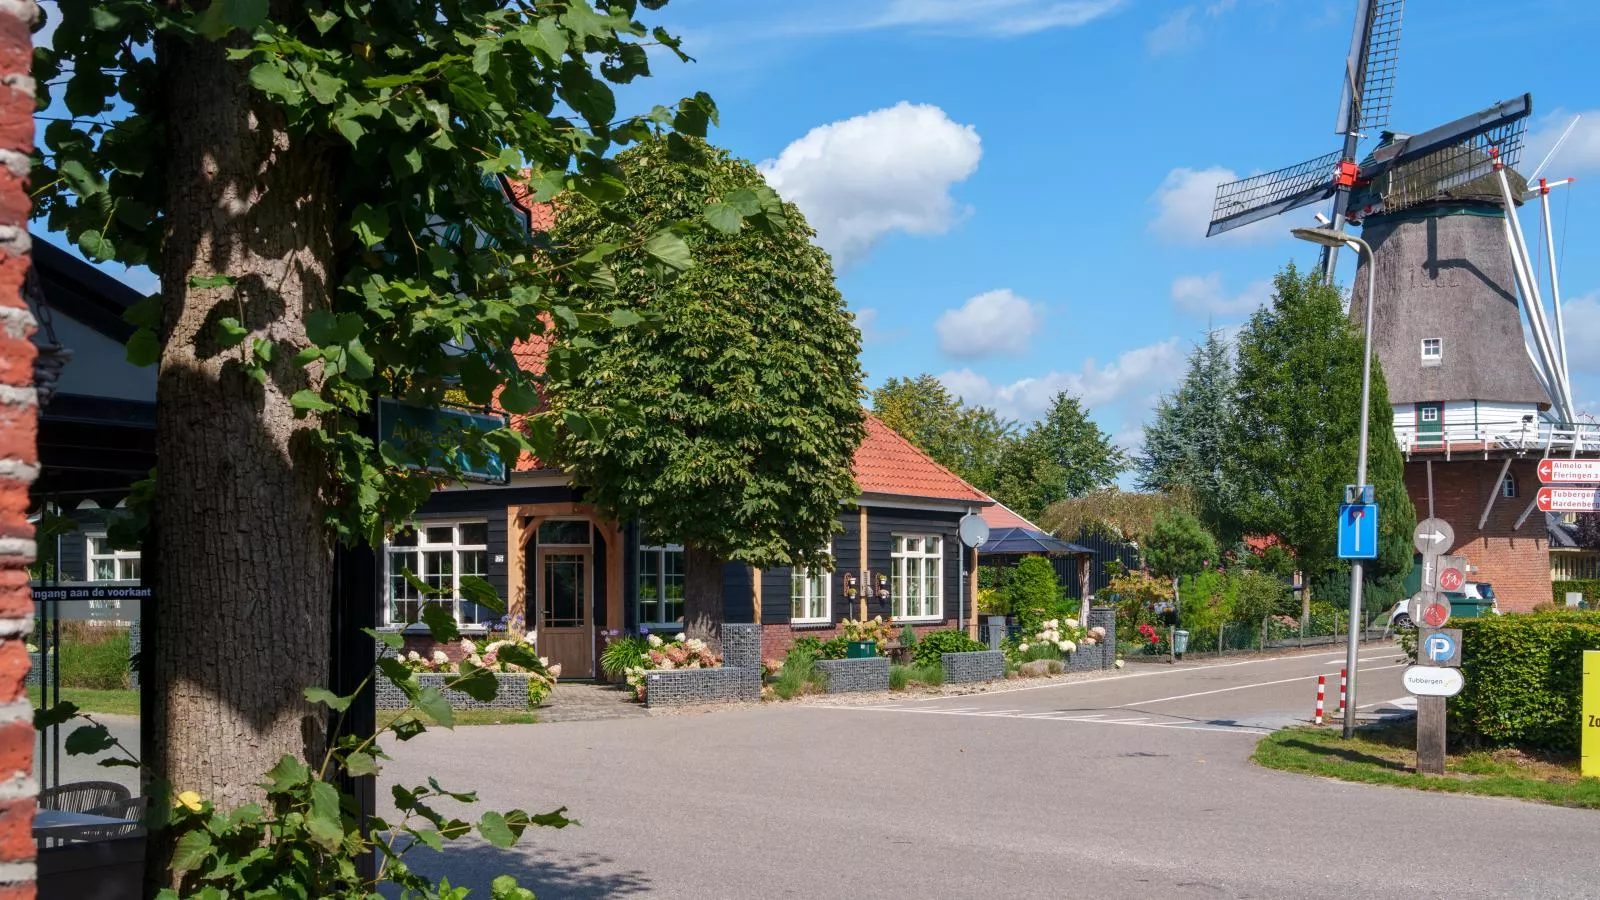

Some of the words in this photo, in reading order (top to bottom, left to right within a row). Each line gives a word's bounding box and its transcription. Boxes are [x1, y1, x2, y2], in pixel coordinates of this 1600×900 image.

[1553, 471, 1592, 479] Fleringen
[1552, 490, 1597, 499] Tubbergen
[69, 589, 89, 597] aan
[92, 587, 105, 597] de
[107, 587, 152, 597] voorkant
[1408, 677, 1443, 685] Tubbergen
